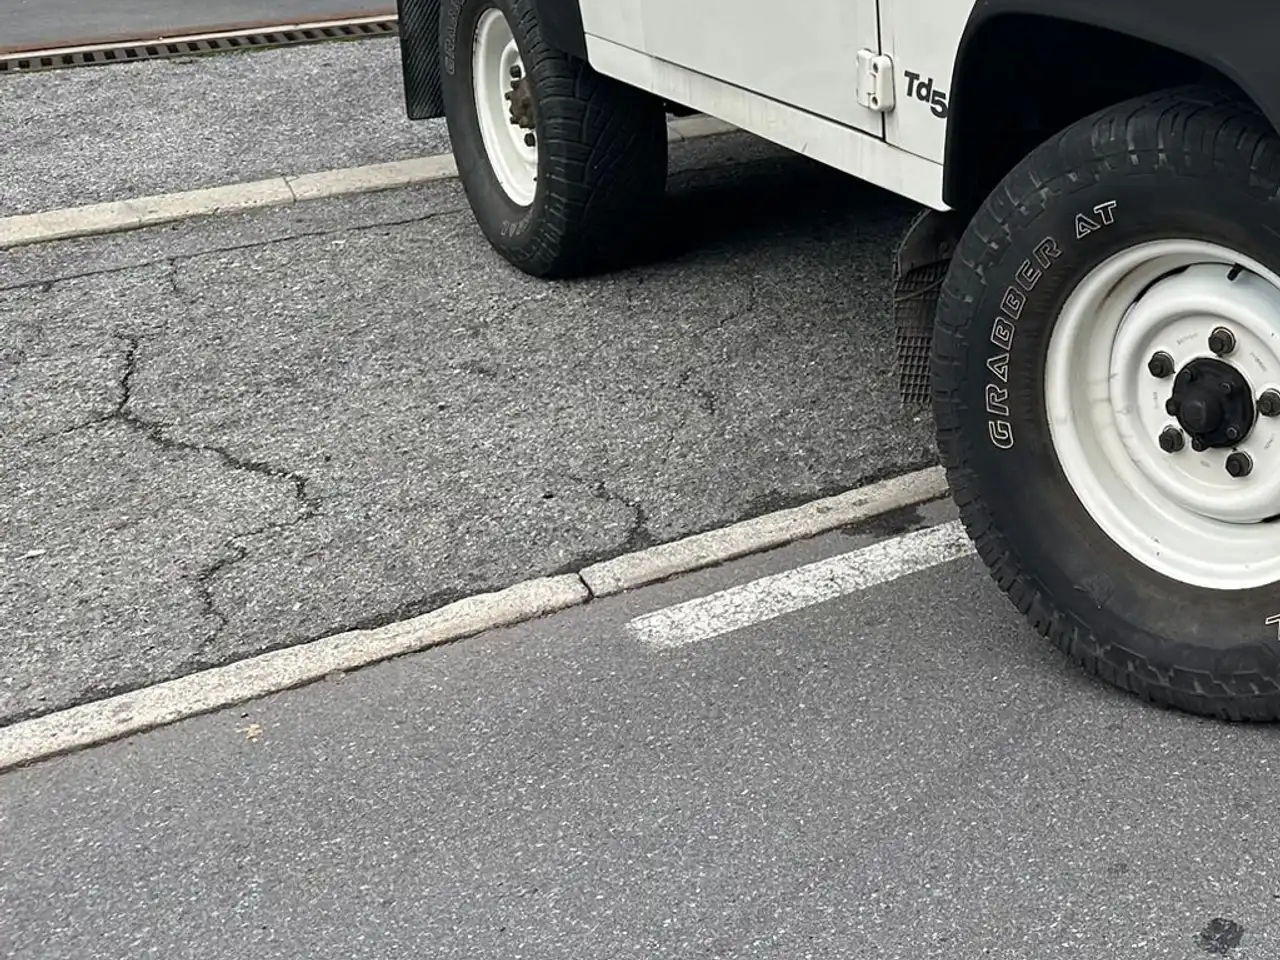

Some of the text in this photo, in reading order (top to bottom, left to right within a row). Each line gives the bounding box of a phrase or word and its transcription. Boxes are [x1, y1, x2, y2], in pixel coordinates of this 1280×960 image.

[904, 70, 948, 119] Td5
[985, 200, 1117, 449] GRABBER AT
